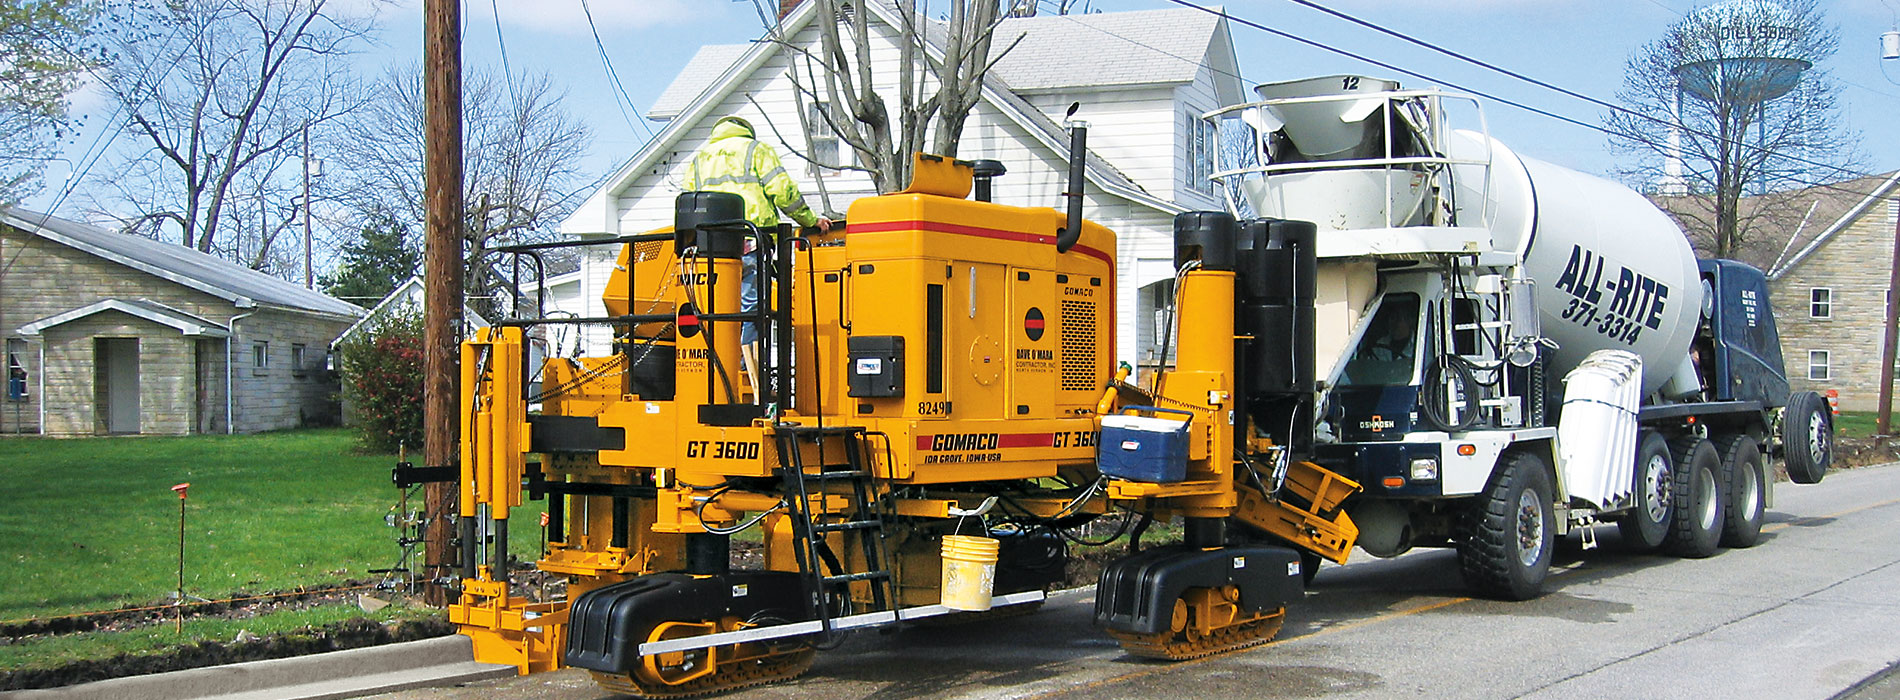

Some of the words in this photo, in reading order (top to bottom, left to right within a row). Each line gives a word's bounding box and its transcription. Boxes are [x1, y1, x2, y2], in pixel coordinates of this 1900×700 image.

[1342, 76, 1360, 90] 12
[1065, 287, 1093, 297] GOMACO
[1555, 244, 1669, 331] ALL-RITE
[1562, 299, 1642, 346] 371-3314
[682, 349, 709, 360] O'MAR
[1017, 349, 1030, 360] DAVE
[918, 401, 945, 415] 8249
[932, 433, 999, 451] GOMACO
[1053, 431, 1071, 448] GT
[1073, 431, 1100, 447] 360
[687, 441, 709, 458] GT
[713, 441, 760, 459] 3600
